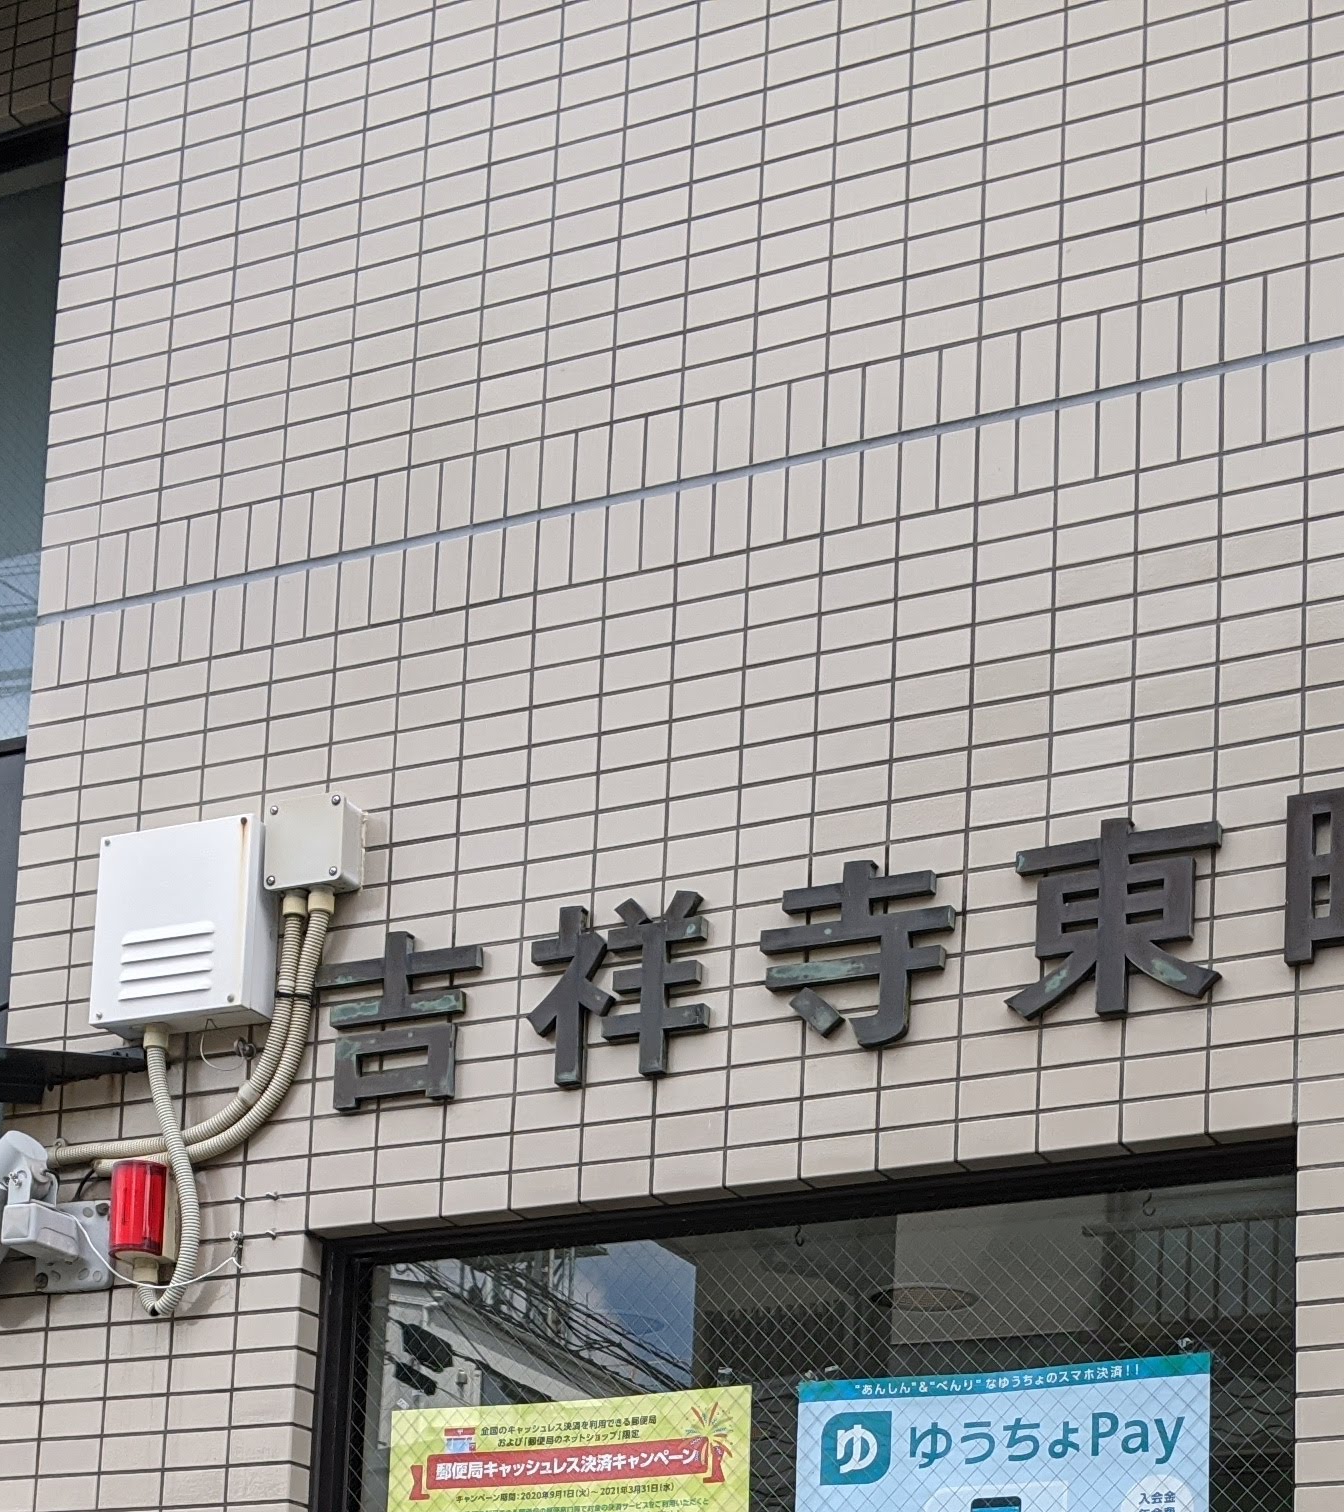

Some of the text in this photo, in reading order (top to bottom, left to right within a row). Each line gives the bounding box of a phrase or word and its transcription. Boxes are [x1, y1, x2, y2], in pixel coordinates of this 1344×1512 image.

[908, 1411, 1185, 1470] ゆうちょPay
[436, 1449, 698, 1481] 郵便局キャッシュレス決済キャンペーン
[1138, 1491, 1176, 1505] 入会金
